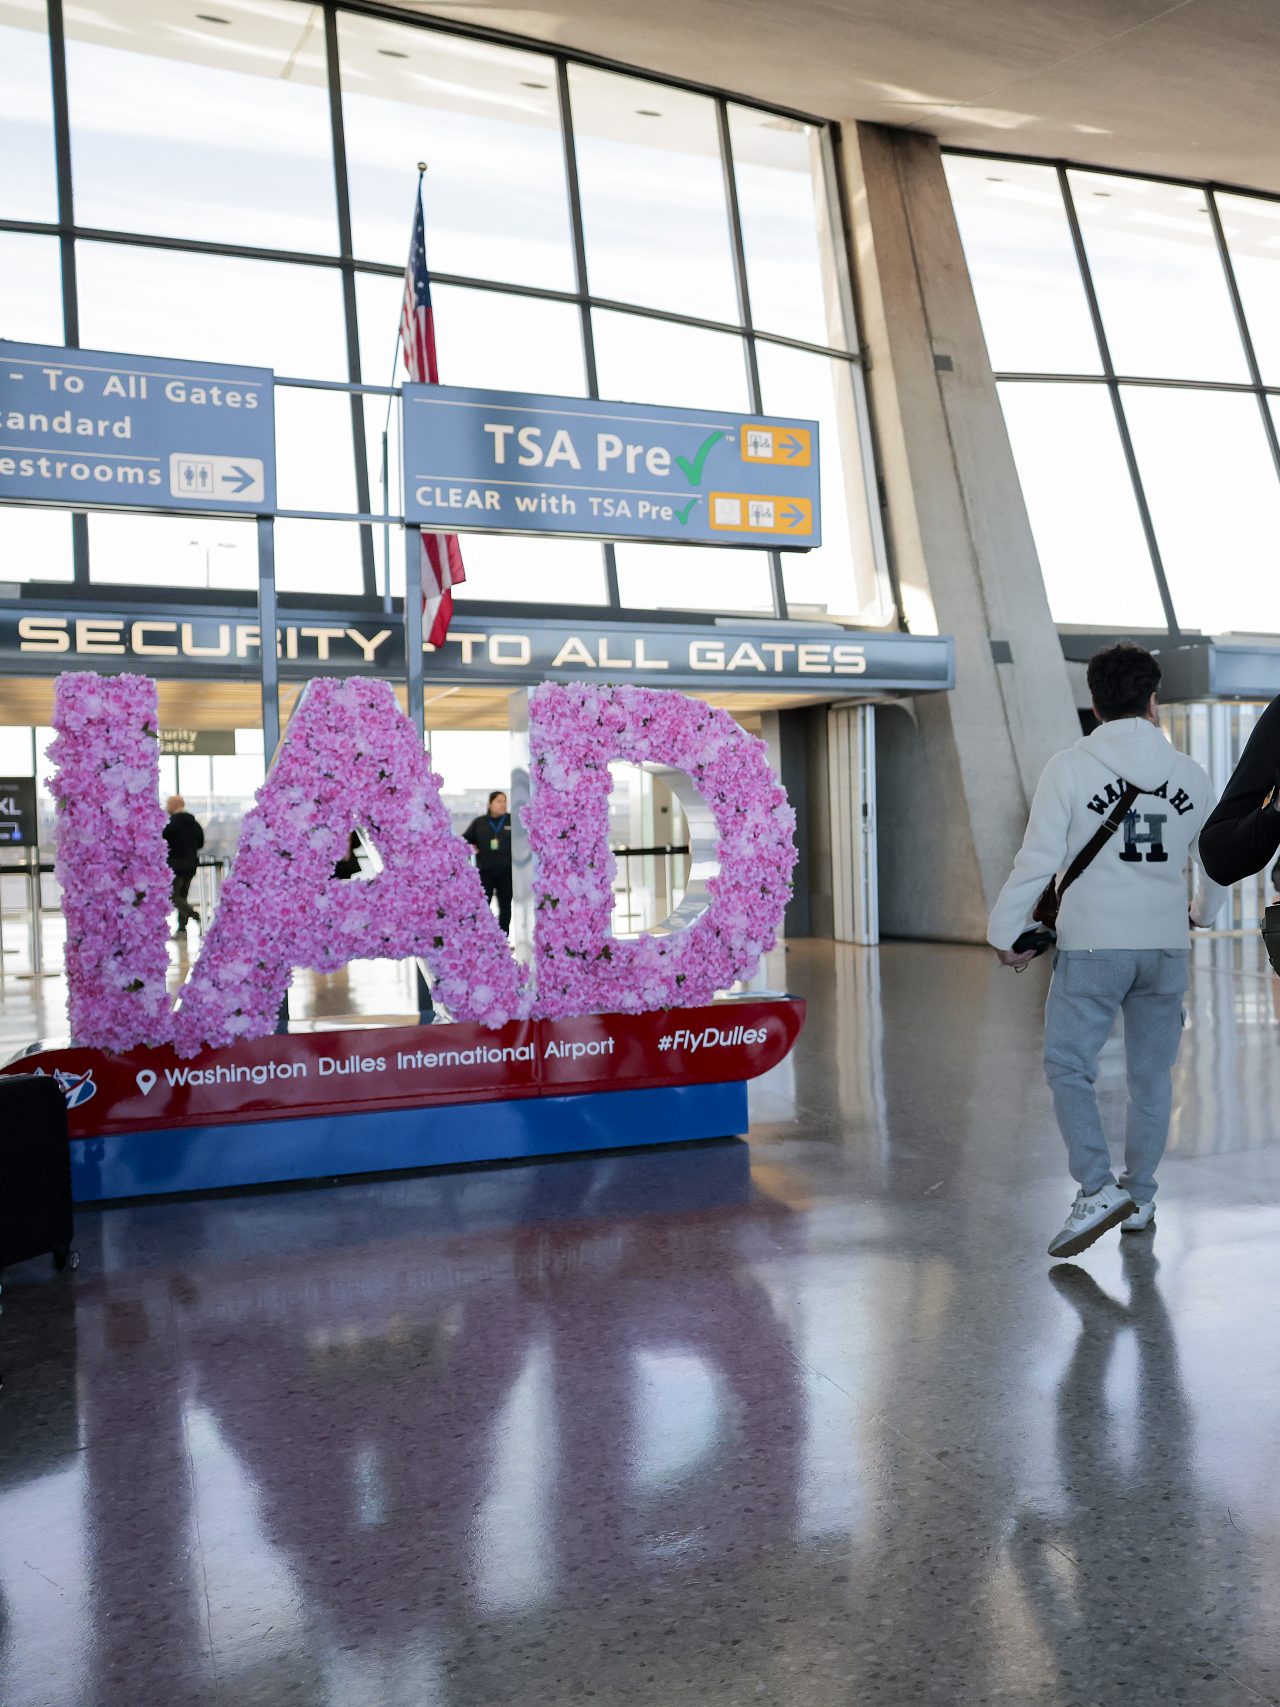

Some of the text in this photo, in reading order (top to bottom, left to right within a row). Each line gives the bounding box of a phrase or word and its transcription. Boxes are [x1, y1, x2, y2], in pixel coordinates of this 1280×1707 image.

[43, 368, 85, 394] To
[103, 374, 147, 400] All
[165, 381, 259, 409] Gates
[0, 410, 132, 440] andard
[484, 423, 582, 471] TSA
[597, 433, 672, 476] Pre
[0, 457, 162, 486] estrooms
[416, 485, 673, 521] CLEAR with TSA Pre
[18, 616, 392, 662] SECURITY
[446, 632, 532, 666] TO
[551, 636, 669, 669] ALL
[688, 640, 867, 674] GATES
[1119, 813, 1168, 862] H
[657, 1026, 768, 1055] #FlyDulles
[164, 1036, 615, 1091] Washington Dulles International Airport
